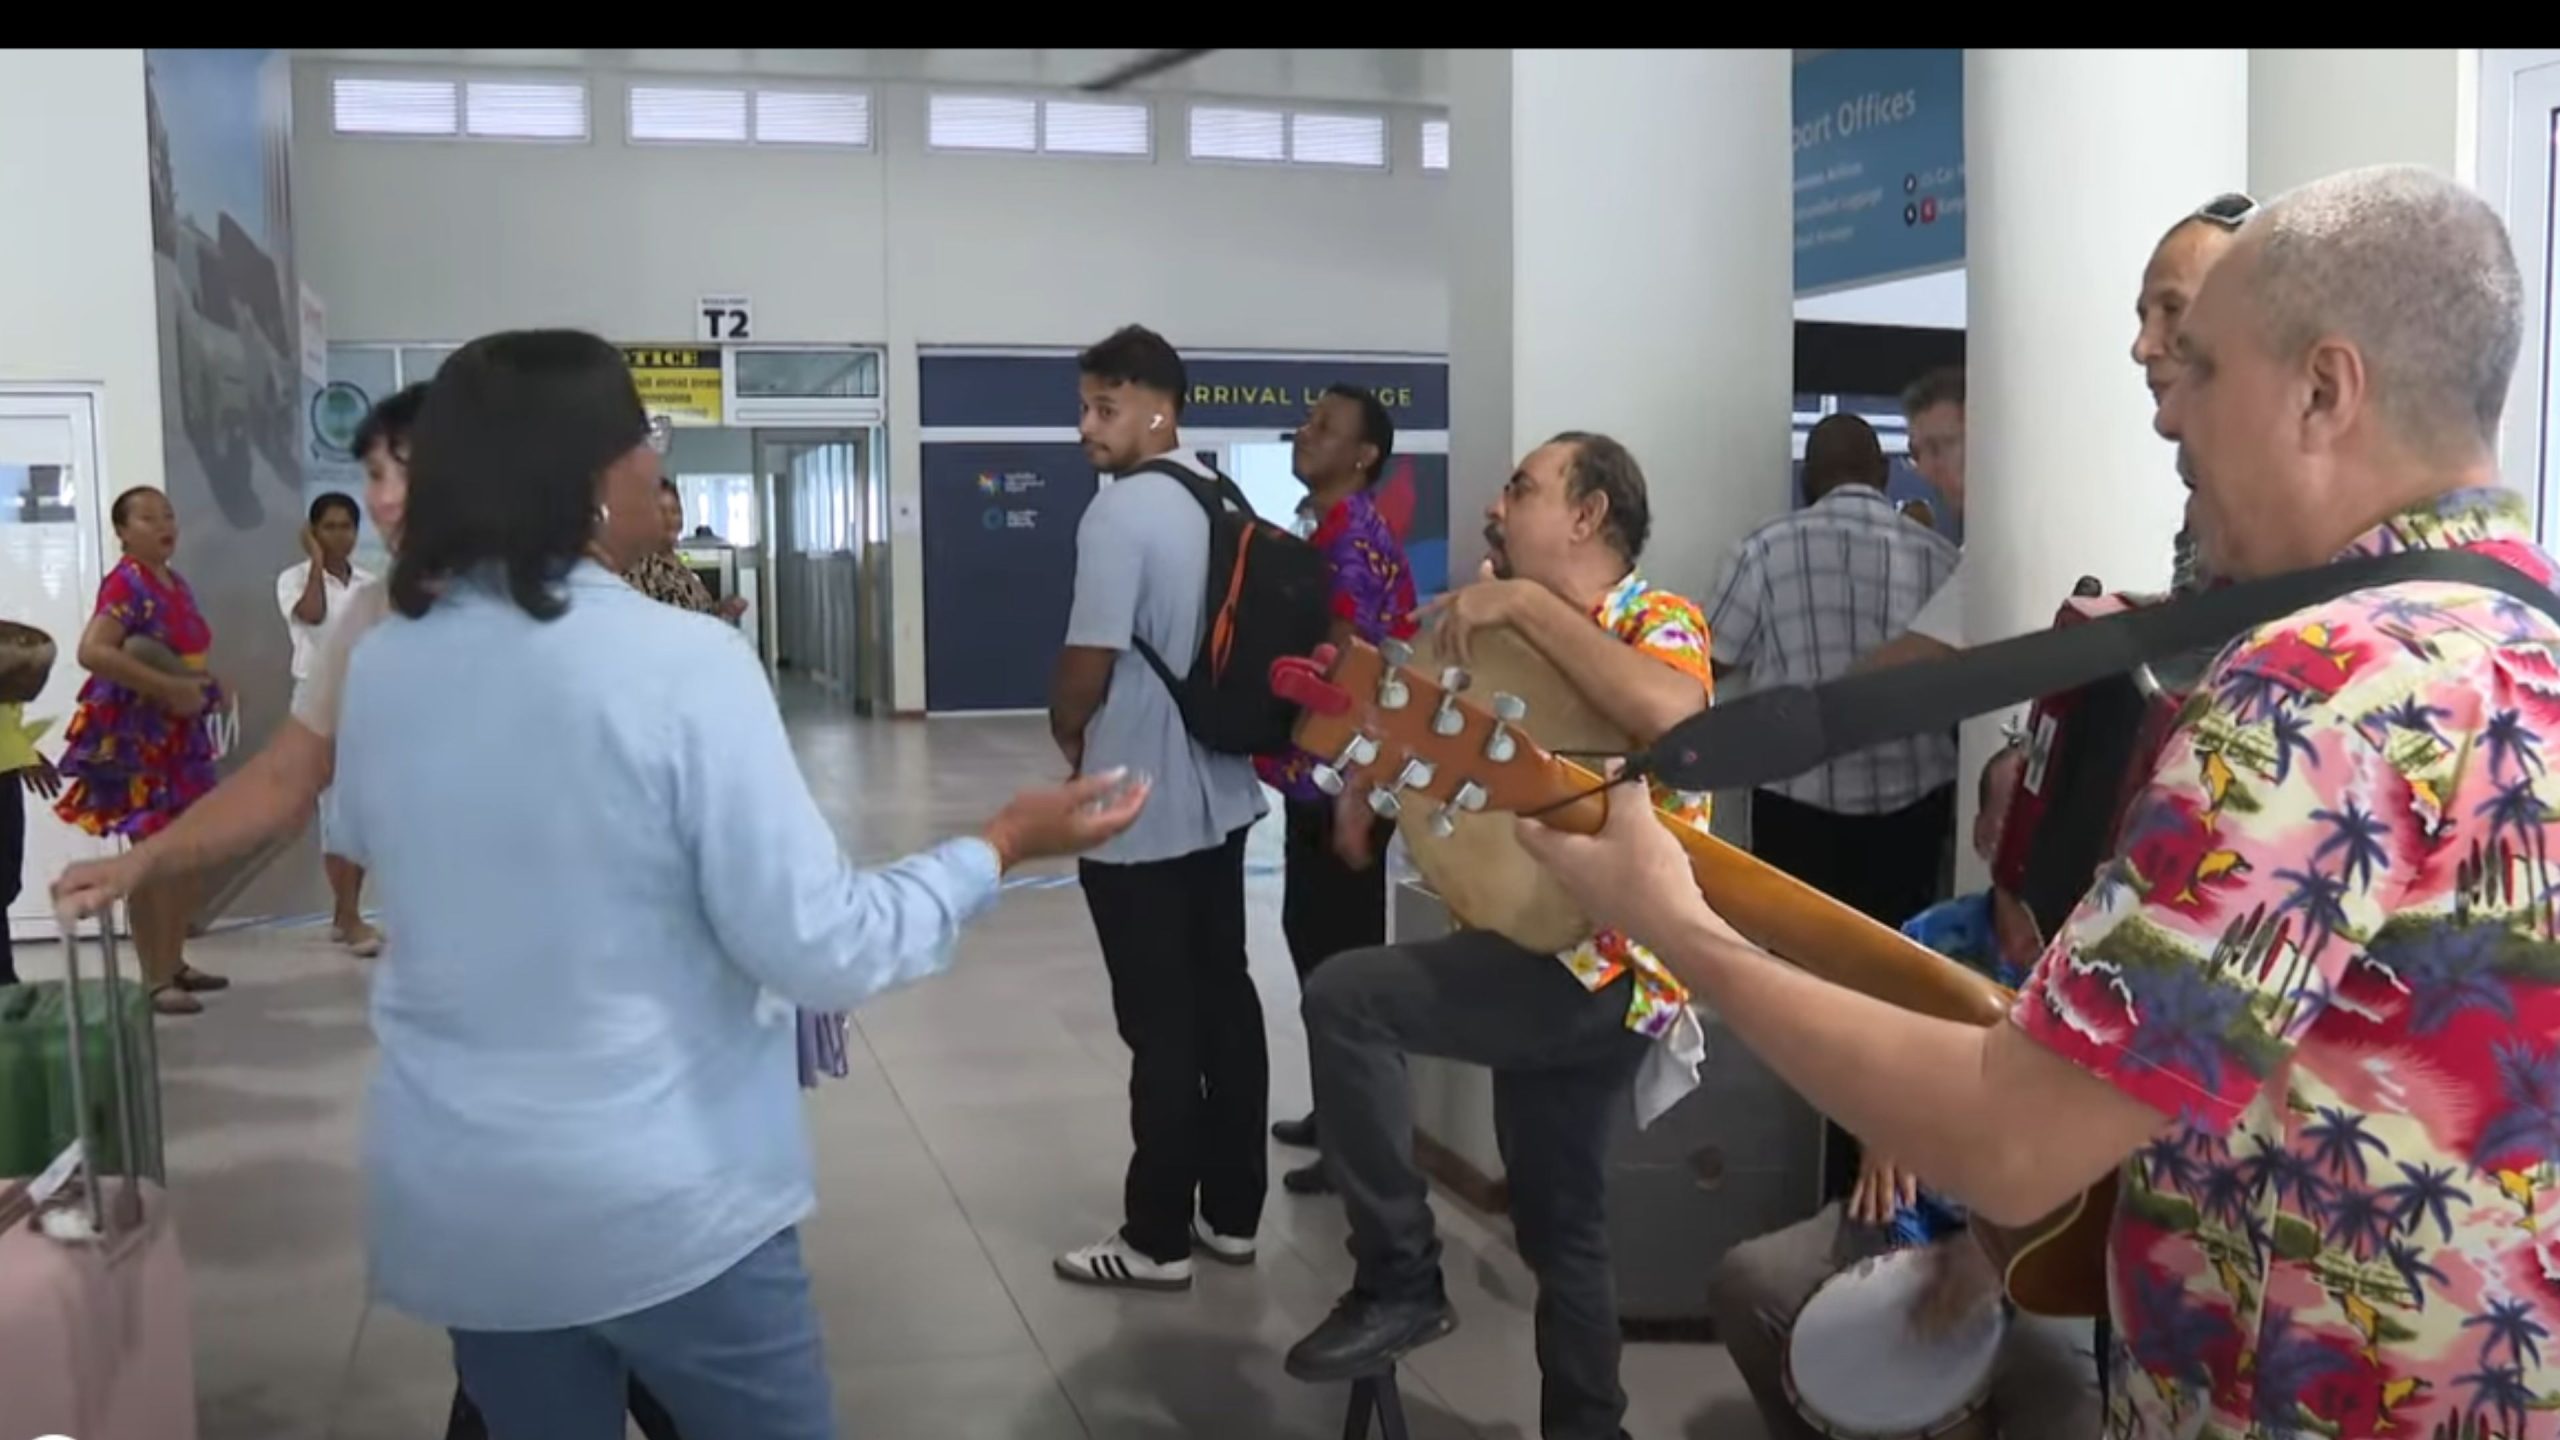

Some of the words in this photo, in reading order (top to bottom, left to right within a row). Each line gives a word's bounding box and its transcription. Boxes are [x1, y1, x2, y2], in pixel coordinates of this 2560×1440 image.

[1838, 87, 1916, 137] Offices
[703, 309, 749, 339] T2
[1304, 387, 1412, 407] LGE
